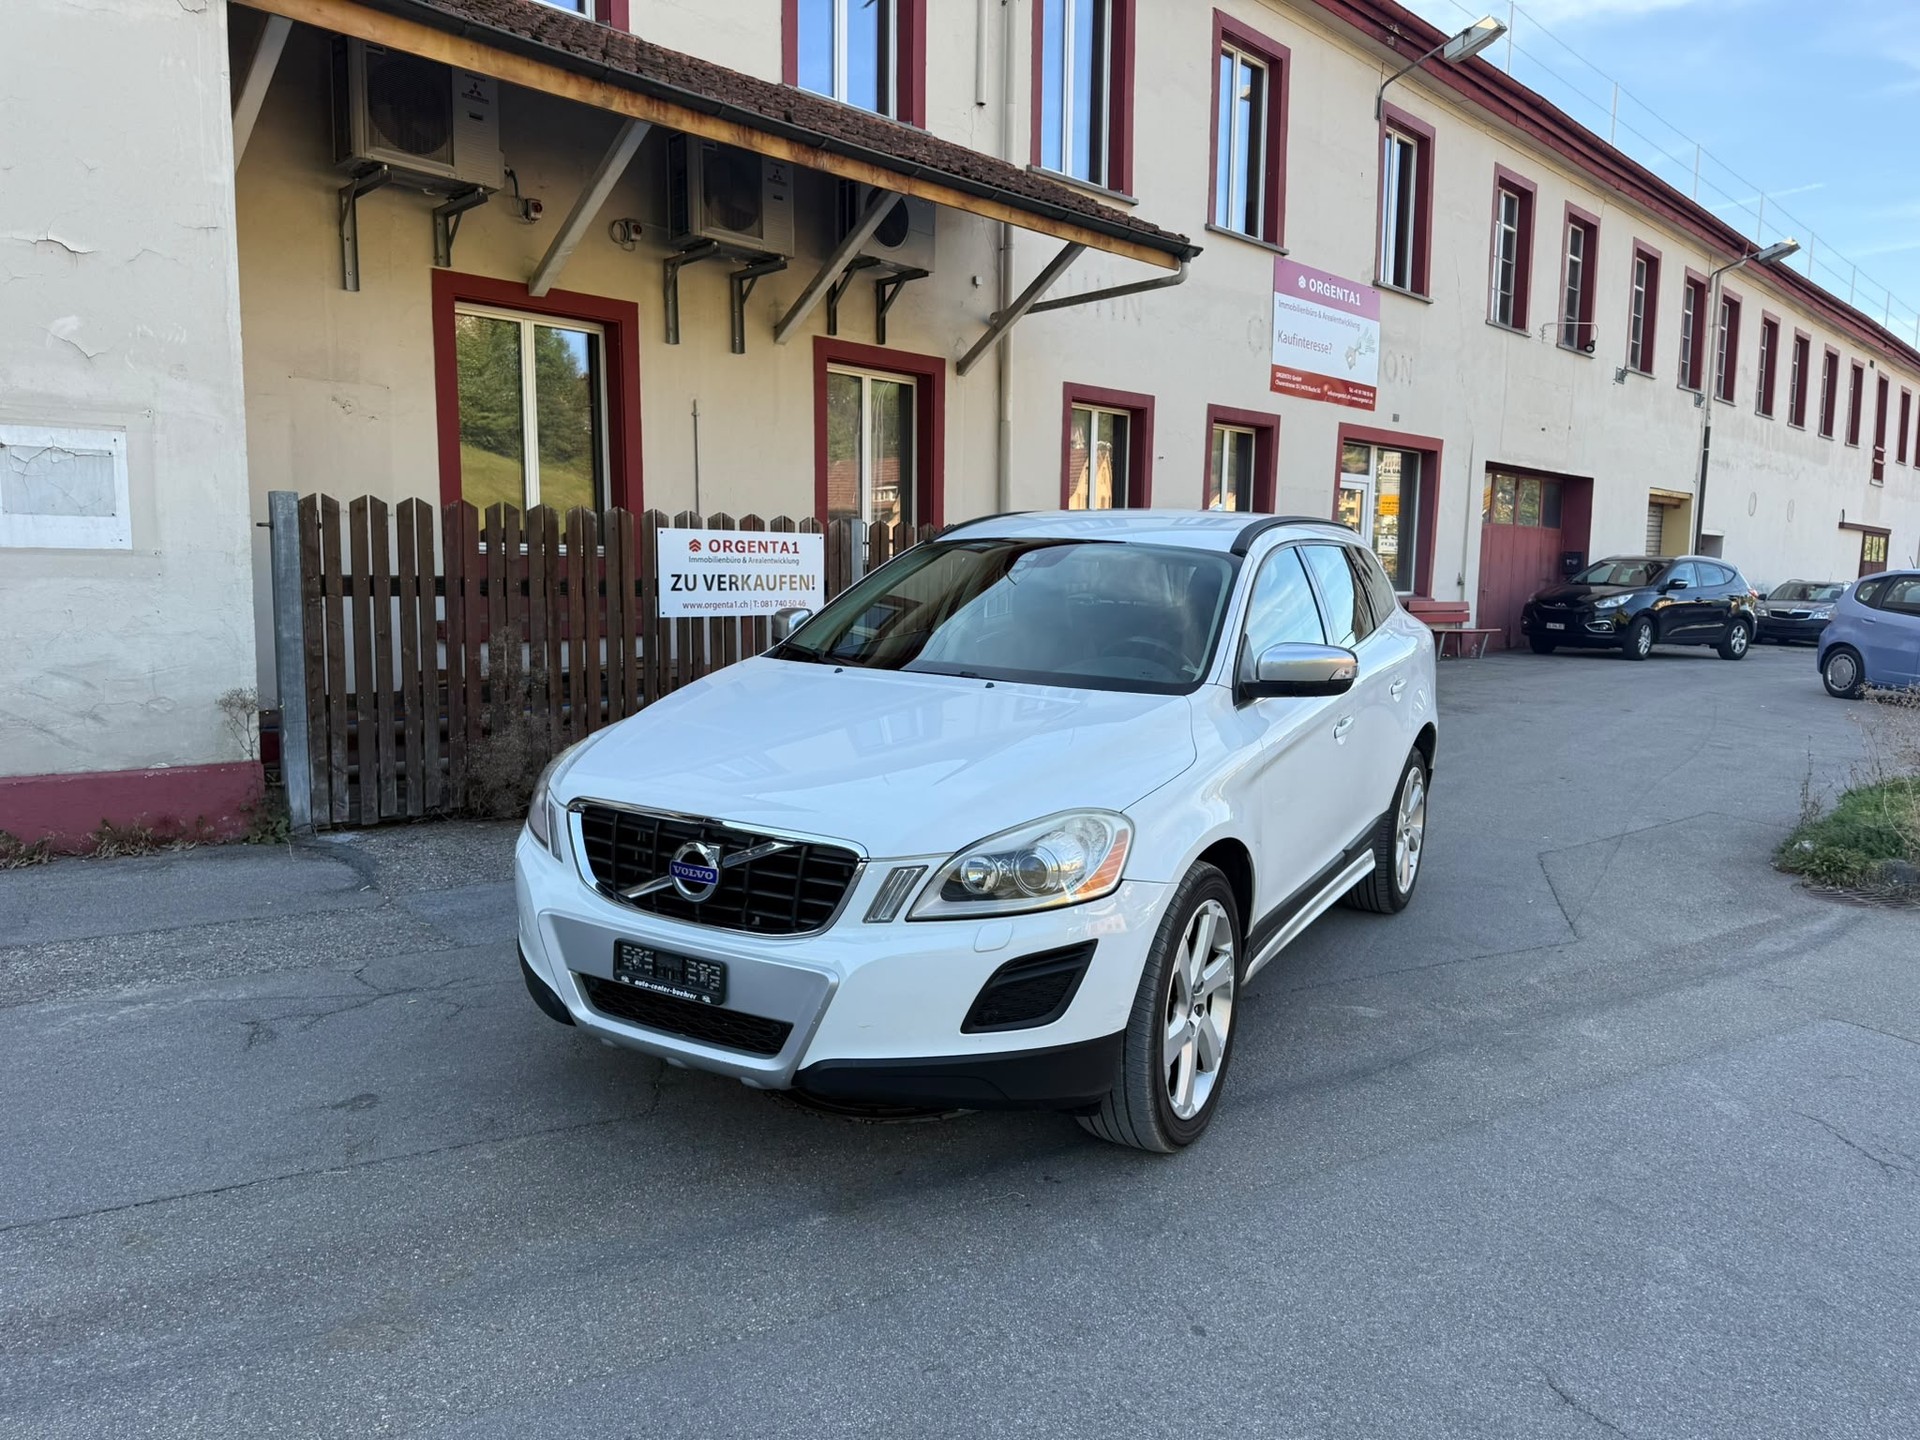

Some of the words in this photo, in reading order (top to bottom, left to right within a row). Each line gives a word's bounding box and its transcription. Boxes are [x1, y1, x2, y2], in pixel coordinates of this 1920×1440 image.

[1309, 278, 1361, 306] ORGENTA1
[1277, 330, 1333, 355] Kaufinteresse?
[708, 539, 800, 554] ORGENTA1
[688, 555, 741, 564] Immobilienbüro
[748, 556, 800, 566] Arealentwicklung
[670, 573, 697, 592] ZU
[703, 574, 816, 592] VERKAUFEN!
[682, 600, 749, 611] www.orgenta1.ch
[753, 600, 759, 608] T:
[760, 600, 773, 608] 081
[774, 600, 787, 608] 740
[788, 600, 797, 608] 50
[673, 865, 714, 880] VOLVO
